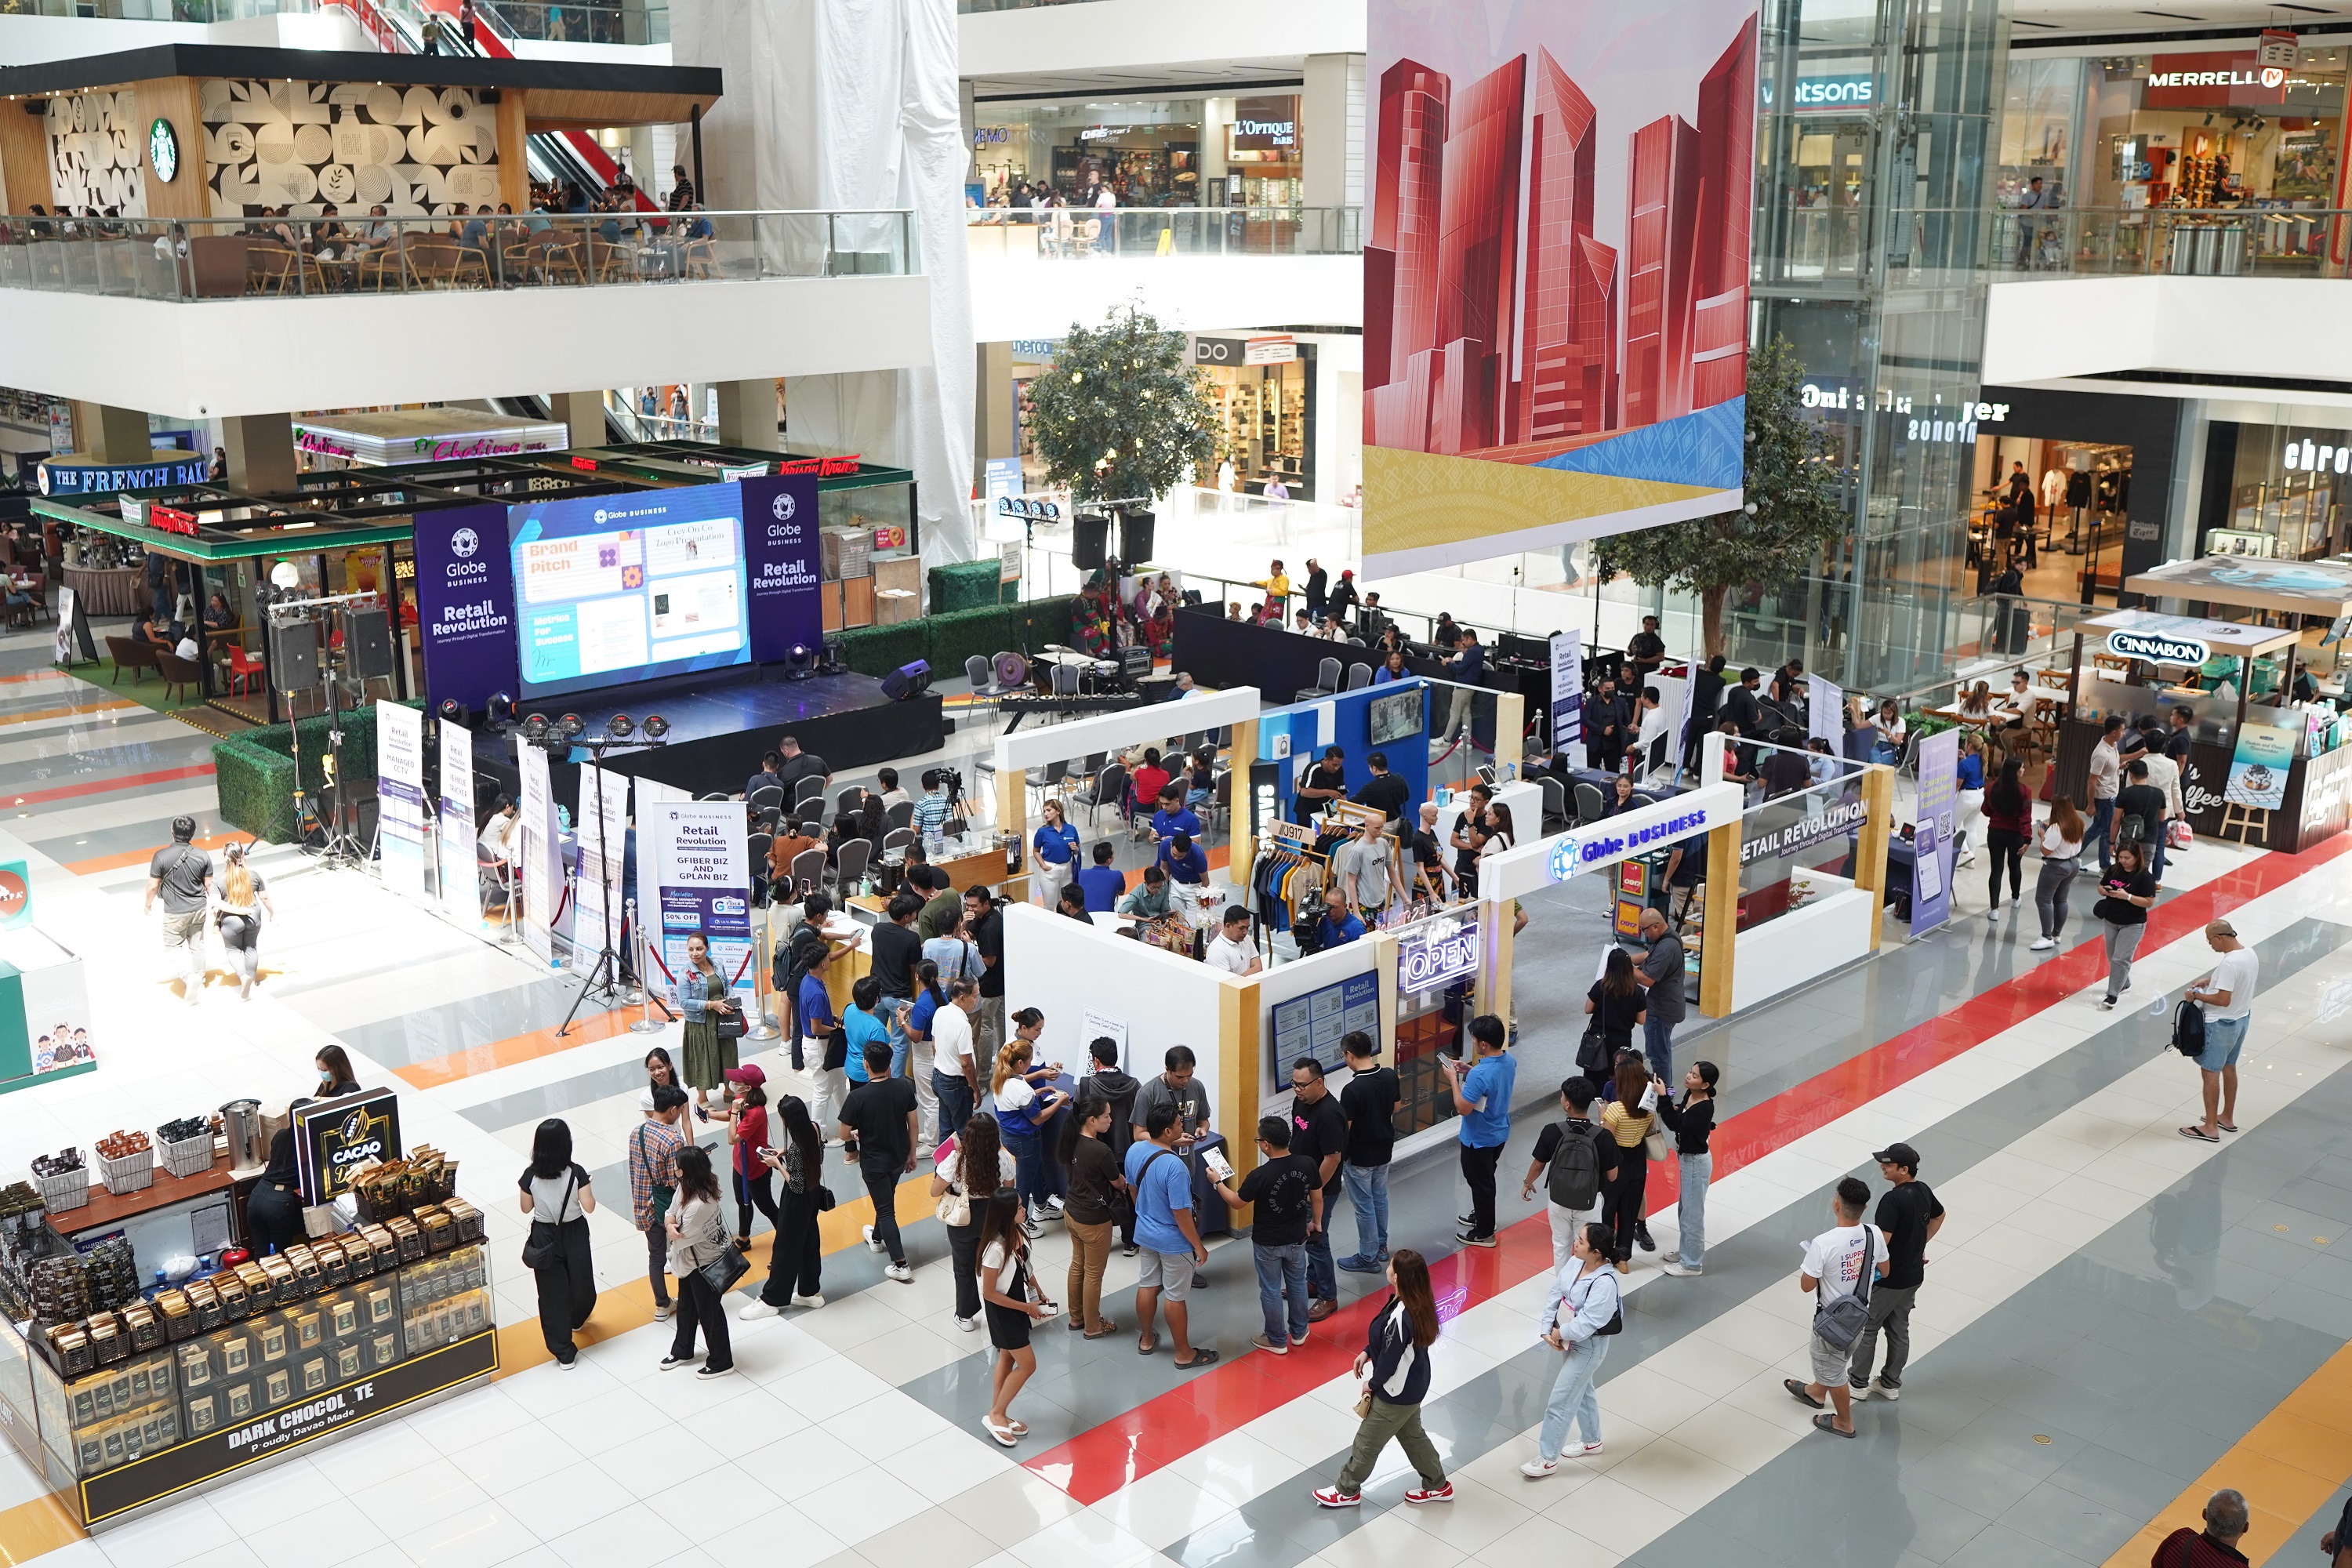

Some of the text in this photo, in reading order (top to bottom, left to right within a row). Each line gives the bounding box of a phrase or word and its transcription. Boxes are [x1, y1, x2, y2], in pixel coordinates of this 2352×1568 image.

[2149, 71, 2259, 87] MERRELL
[1235, 120, 1293, 136] L'OPTIQUE
[1272, 136, 1294, 145] PARIS
[433, 439, 520, 461] Chatime
[2285, 438, 2352, 474] chro
[56, 462, 208, 492] THE FRENCH BAK
[608, 506, 666, 520] Globe BUSINESS
[768, 523, 801, 537] Globe
[529, 540, 579, 557] Brand
[768, 538, 802, 546] BUSINESS
[446, 561, 487, 577] Globe
[531, 557, 571, 574] Pitch
[764, 559, 806, 577] Retail
[447, 576, 488, 588] BUSINESS
[753, 573, 817, 589] Revolution
[444, 599, 494, 622] Retail
[433, 615, 507, 636] Revolution
[2113, 635, 2201, 661] CINNABON
[391, 727, 408, 739] Retail
[593, 791, 613, 806] Rtail
[590, 801, 616, 816] Revution
[1784, 798, 1869, 846] REVOLUTION
[682, 826, 719, 836] Retail
[1581, 810, 1706, 862] Globe BUSINESS
[1780, 817, 1866, 856] Journey through Digital Transformation
[676, 837, 727, 846] Revolution
[1426, 921, 1462, 950] We're
[1408, 934, 1476, 981] OPEN
[1345, 986, 1374, 1002] Revolution
[1349, 979, 1370, 994] Retail
[332, 1141, 382, 1164] CACAO
[1845, 1249, 1866, 1260] SUPPO
[1841, 1258, 1864, 1269] FILIPI
[1841, 1266, 1861, 1276] COCO
[1841, 1274, 1860, 1283] FARM
[227, 1381, 375, 1450] DARK CHOCOLTE
[251, 1409, 355, 1453] Poudly Davao Made
